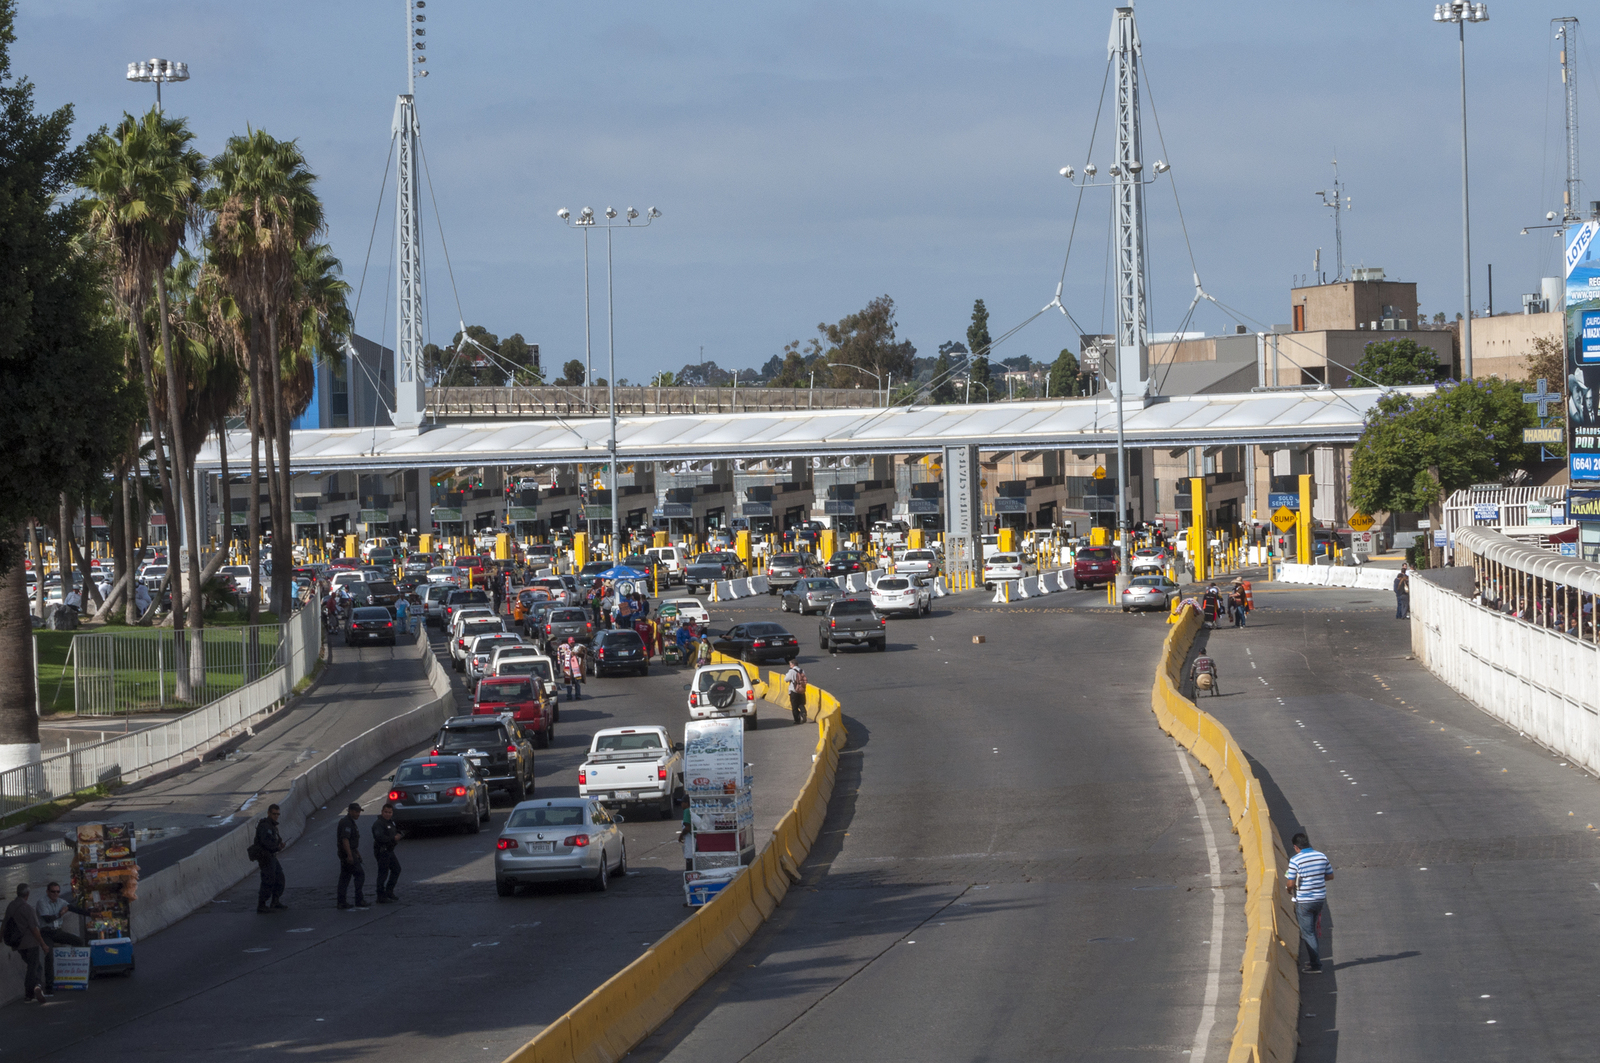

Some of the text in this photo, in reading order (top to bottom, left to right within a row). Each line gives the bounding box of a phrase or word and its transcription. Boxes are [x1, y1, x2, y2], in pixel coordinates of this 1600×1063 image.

[1567, 225, 1591, 266] LOTES
[1571, 291, 1600, 301] www.gru
[1524, 429, 1560, 442] PHARMACY
[1575, 437, 1594, 448] POR
[1573, 457, 1591, 470] (664)
[1570, 497, 1600, 515] FARMA
